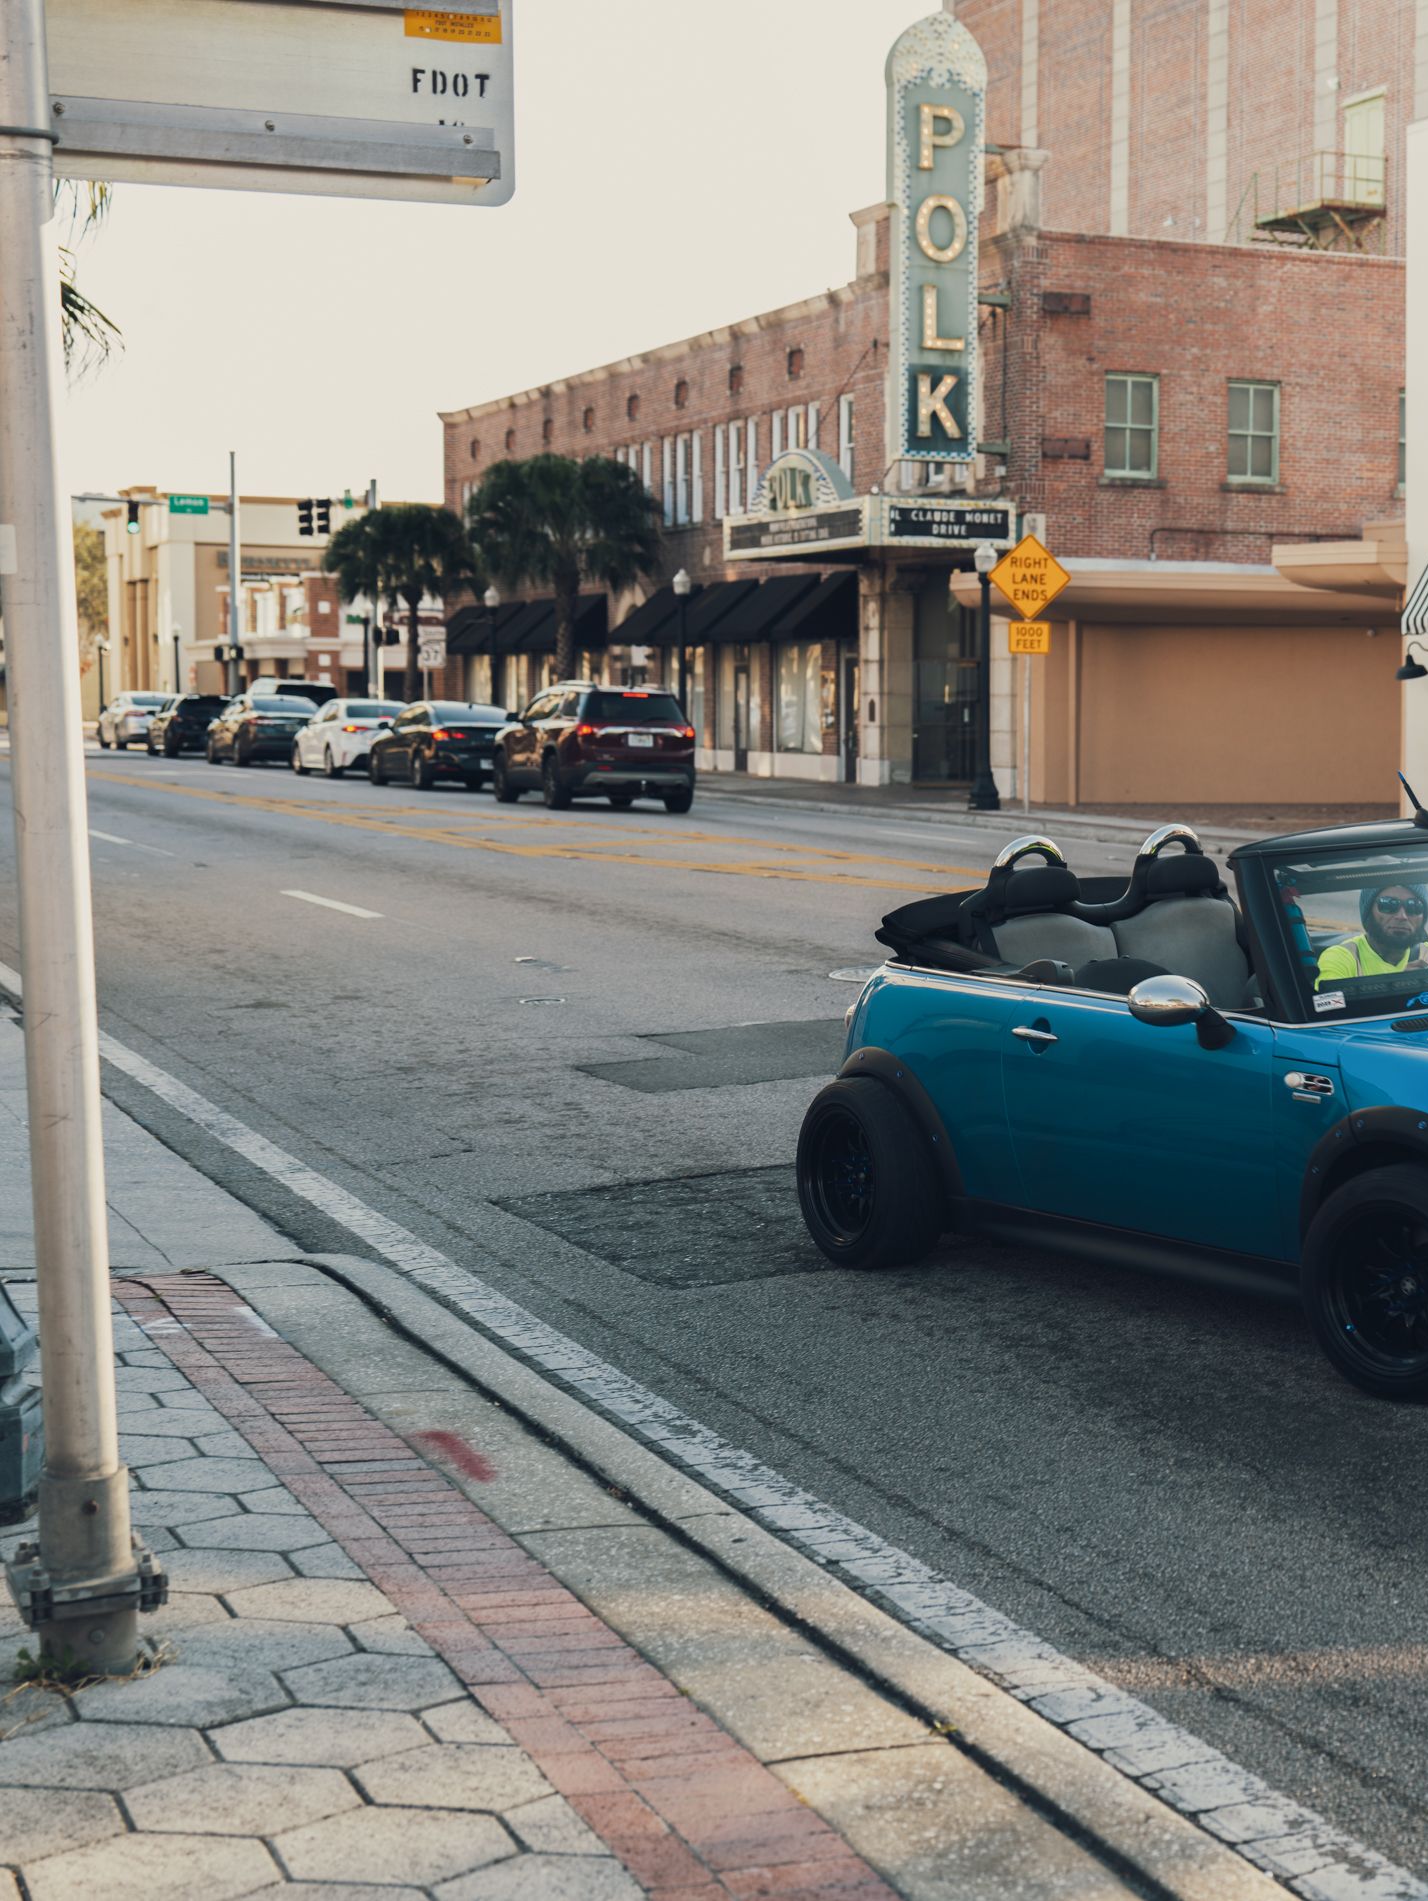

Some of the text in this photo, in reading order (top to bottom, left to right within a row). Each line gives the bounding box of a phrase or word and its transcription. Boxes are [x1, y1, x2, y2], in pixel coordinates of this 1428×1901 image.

[412, 67, 490, 98] FDOT
[916, 103, 968, 439] POLK
[910, 509, 956, 522] CLAUDE
[964, 512, 1003, 524] MONET
[932, 523, 967, 536] DRIVE
[1010, 556, 1049, 569] RIGHT
[1011, 573, 1047, 585] LANE
[1012, 588, 1048, 601] ENDS
[1015, 626, 1043, 637] 1000
[1016, 638, 1042, 649] FEET
